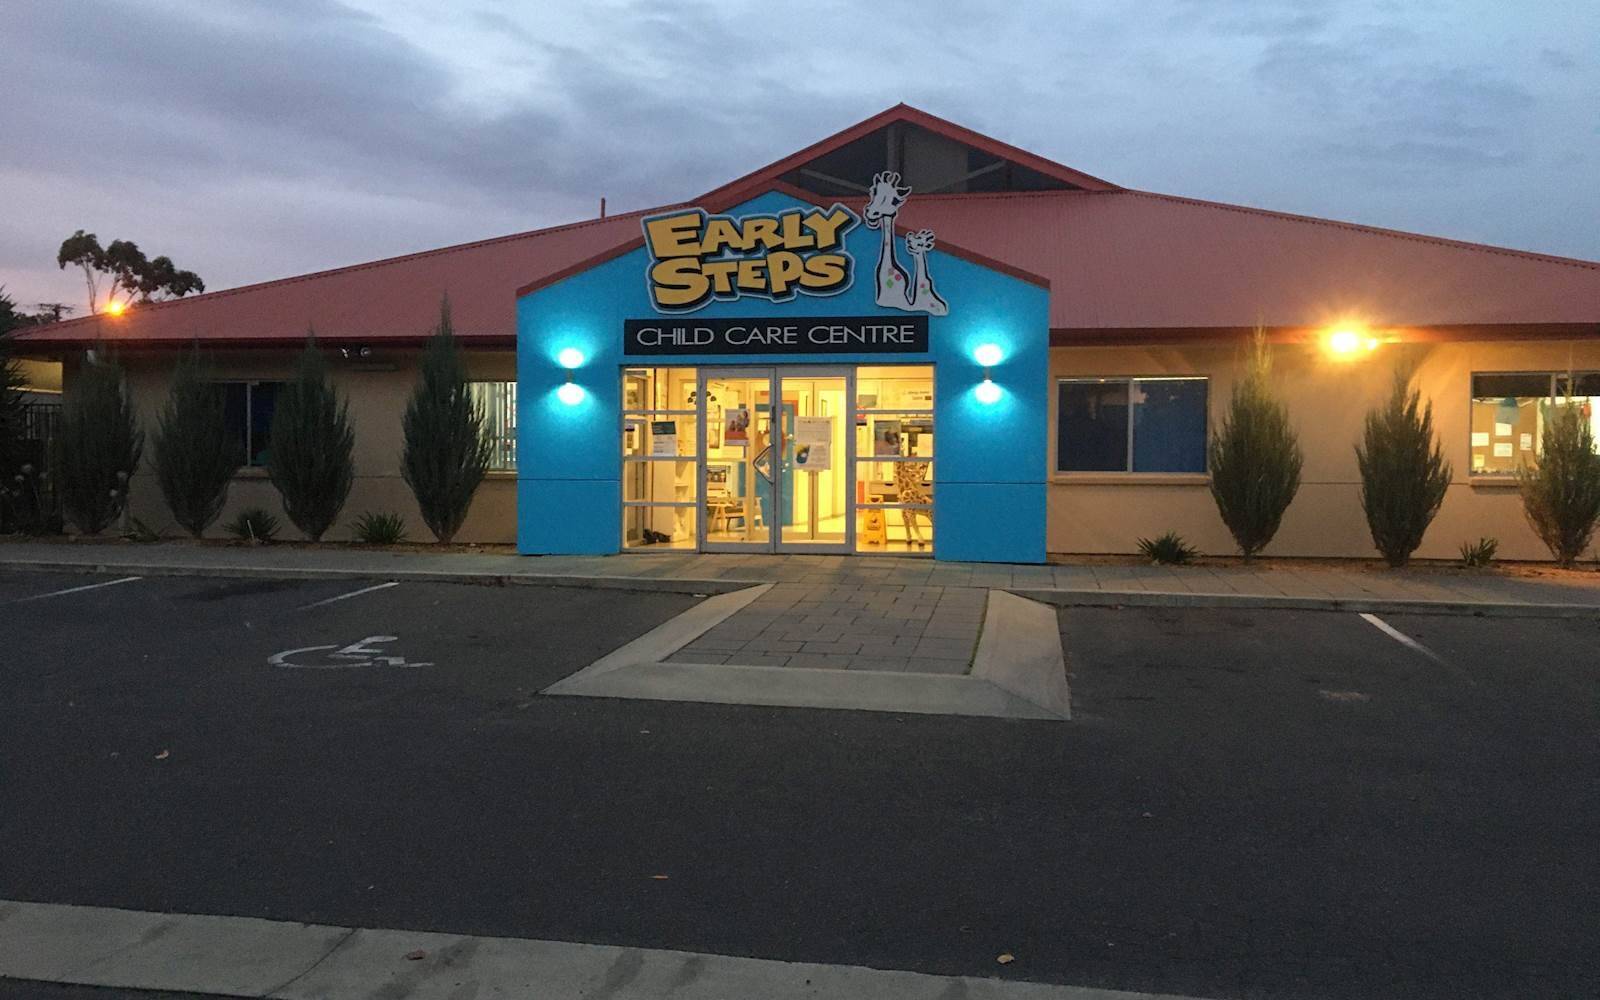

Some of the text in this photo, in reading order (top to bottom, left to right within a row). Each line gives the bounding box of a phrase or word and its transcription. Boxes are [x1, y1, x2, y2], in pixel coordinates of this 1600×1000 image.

[647, 210, 849, 258] EARLY
[652, 252, 847, 305] STEPS
[636, 325, 915, 346] CHILD CARE CENTRE
